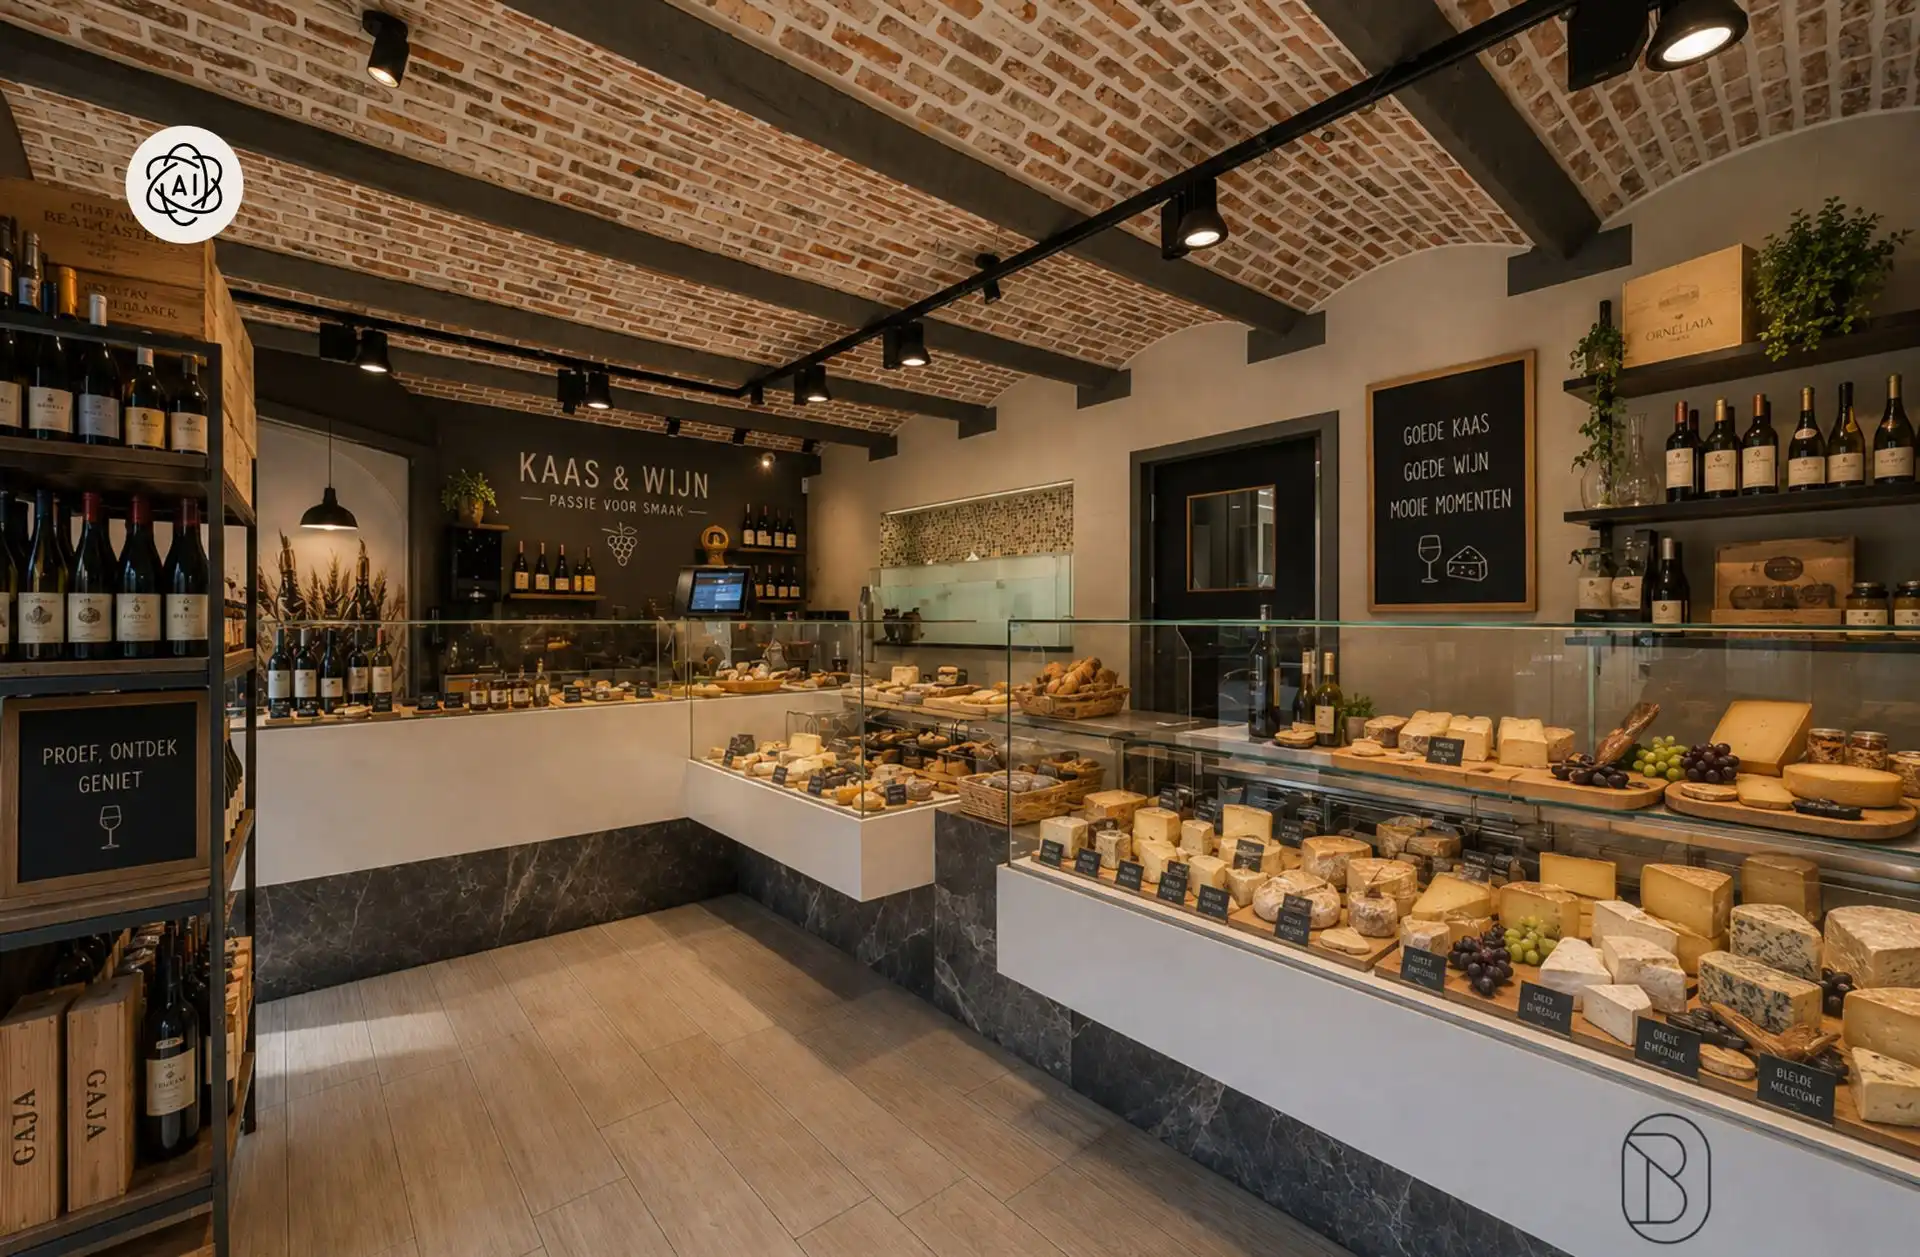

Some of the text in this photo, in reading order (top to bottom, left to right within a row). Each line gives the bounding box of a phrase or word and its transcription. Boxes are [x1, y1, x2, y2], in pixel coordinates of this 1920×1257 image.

[1403, 413, 1490, 446] GOEDE KAAS
[519, 451, 708, 499] KAAS & WIJN
[1404, 451, 1489, 482] GOEDE WIJN
[549, 494, 684, 517] PASSIE VOOR SMAAK
[1390, 487, 1511, 519] MOOIE MOMENTEN
[43, 739, 178, 765] PROEF, ONTDEK
[78, 771, 143, 793] GENIET
[86, 1069, 107, 1142] GAJA
[12, 1089, 38, 1166] GAJA
